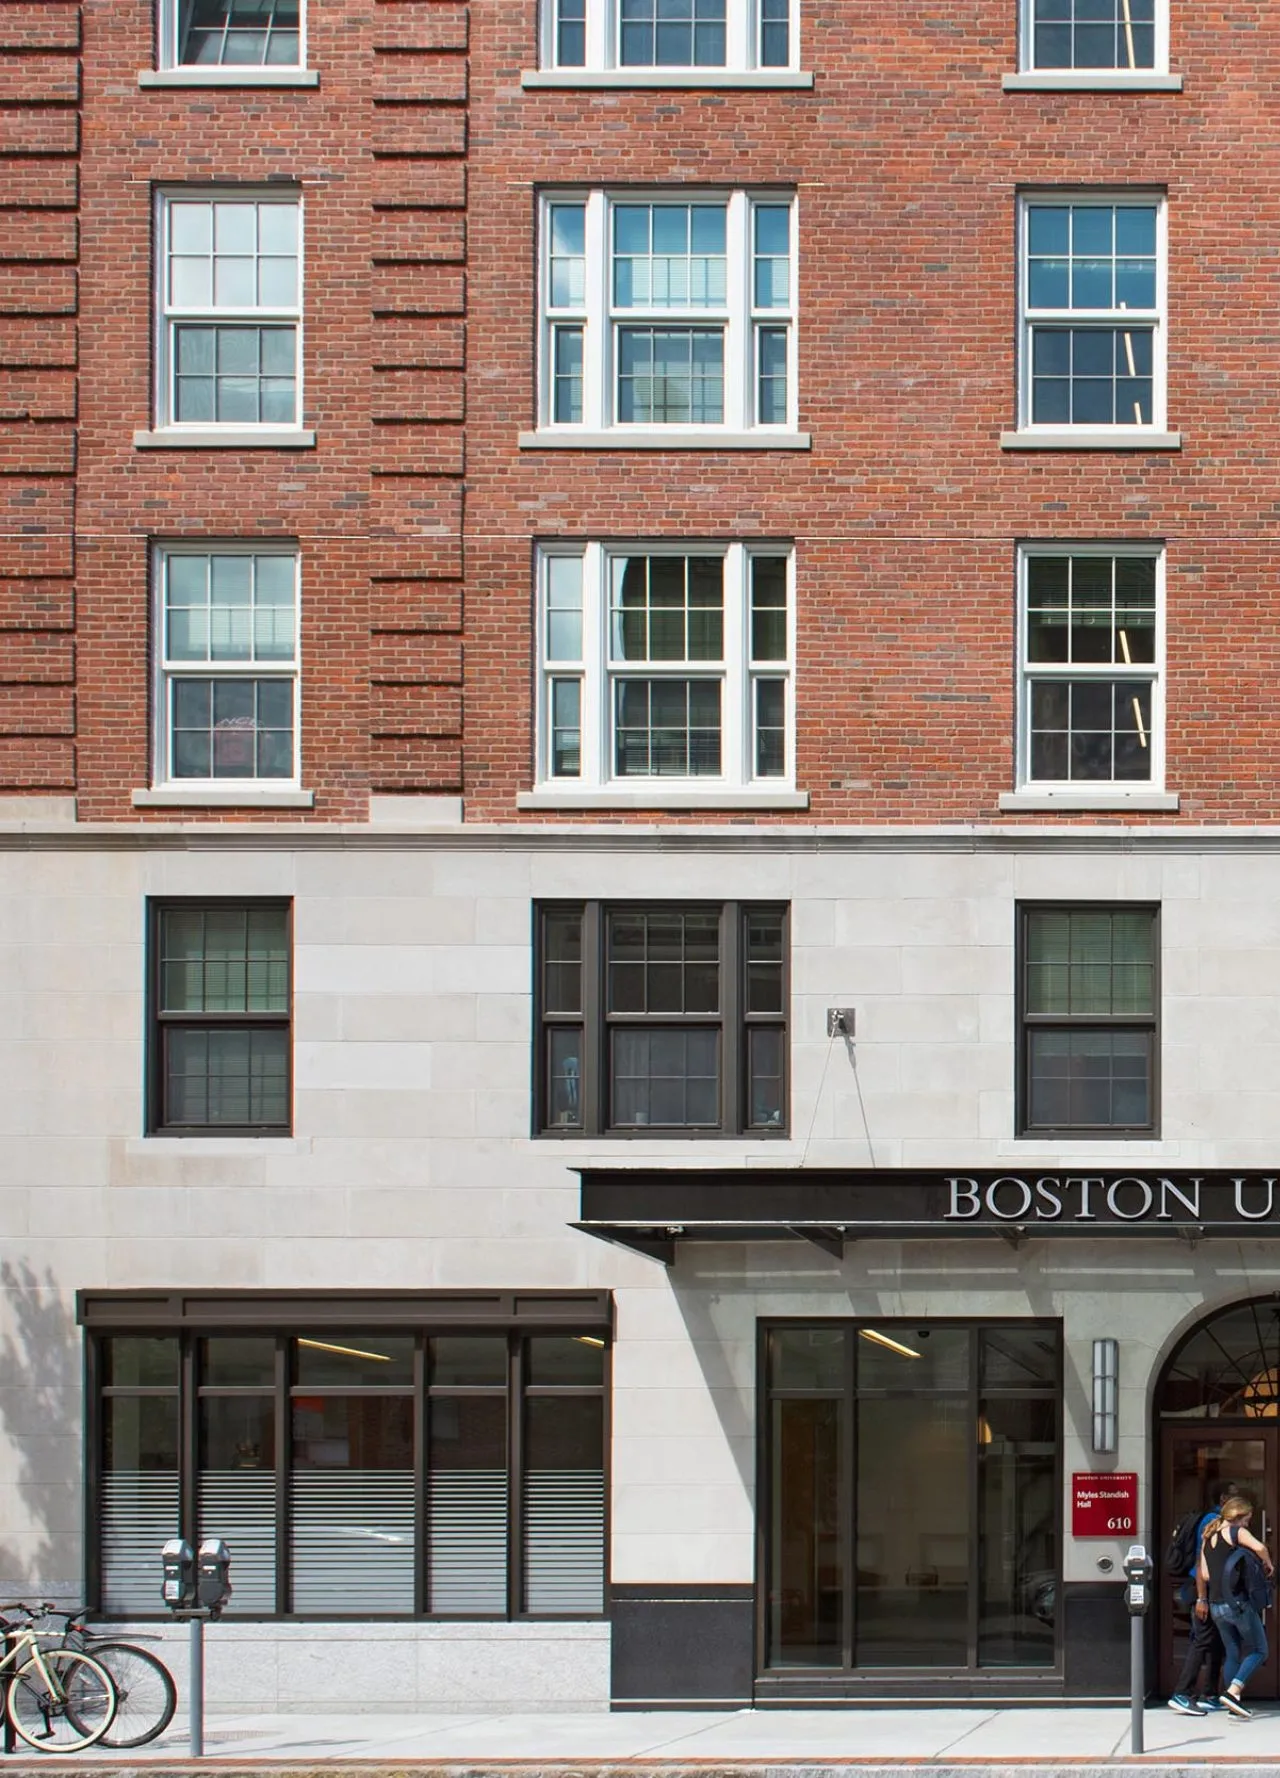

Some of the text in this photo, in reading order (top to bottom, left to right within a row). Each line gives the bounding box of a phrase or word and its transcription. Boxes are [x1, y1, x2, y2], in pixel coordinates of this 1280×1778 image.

[944, 1177, 1205, 1219] BOSTON
[1077, 1490, 1130, 1500] Myles Standish
[1077, 1500, 1092, 1508] Hall
[1107, 1517, 1132, 1529] 610
